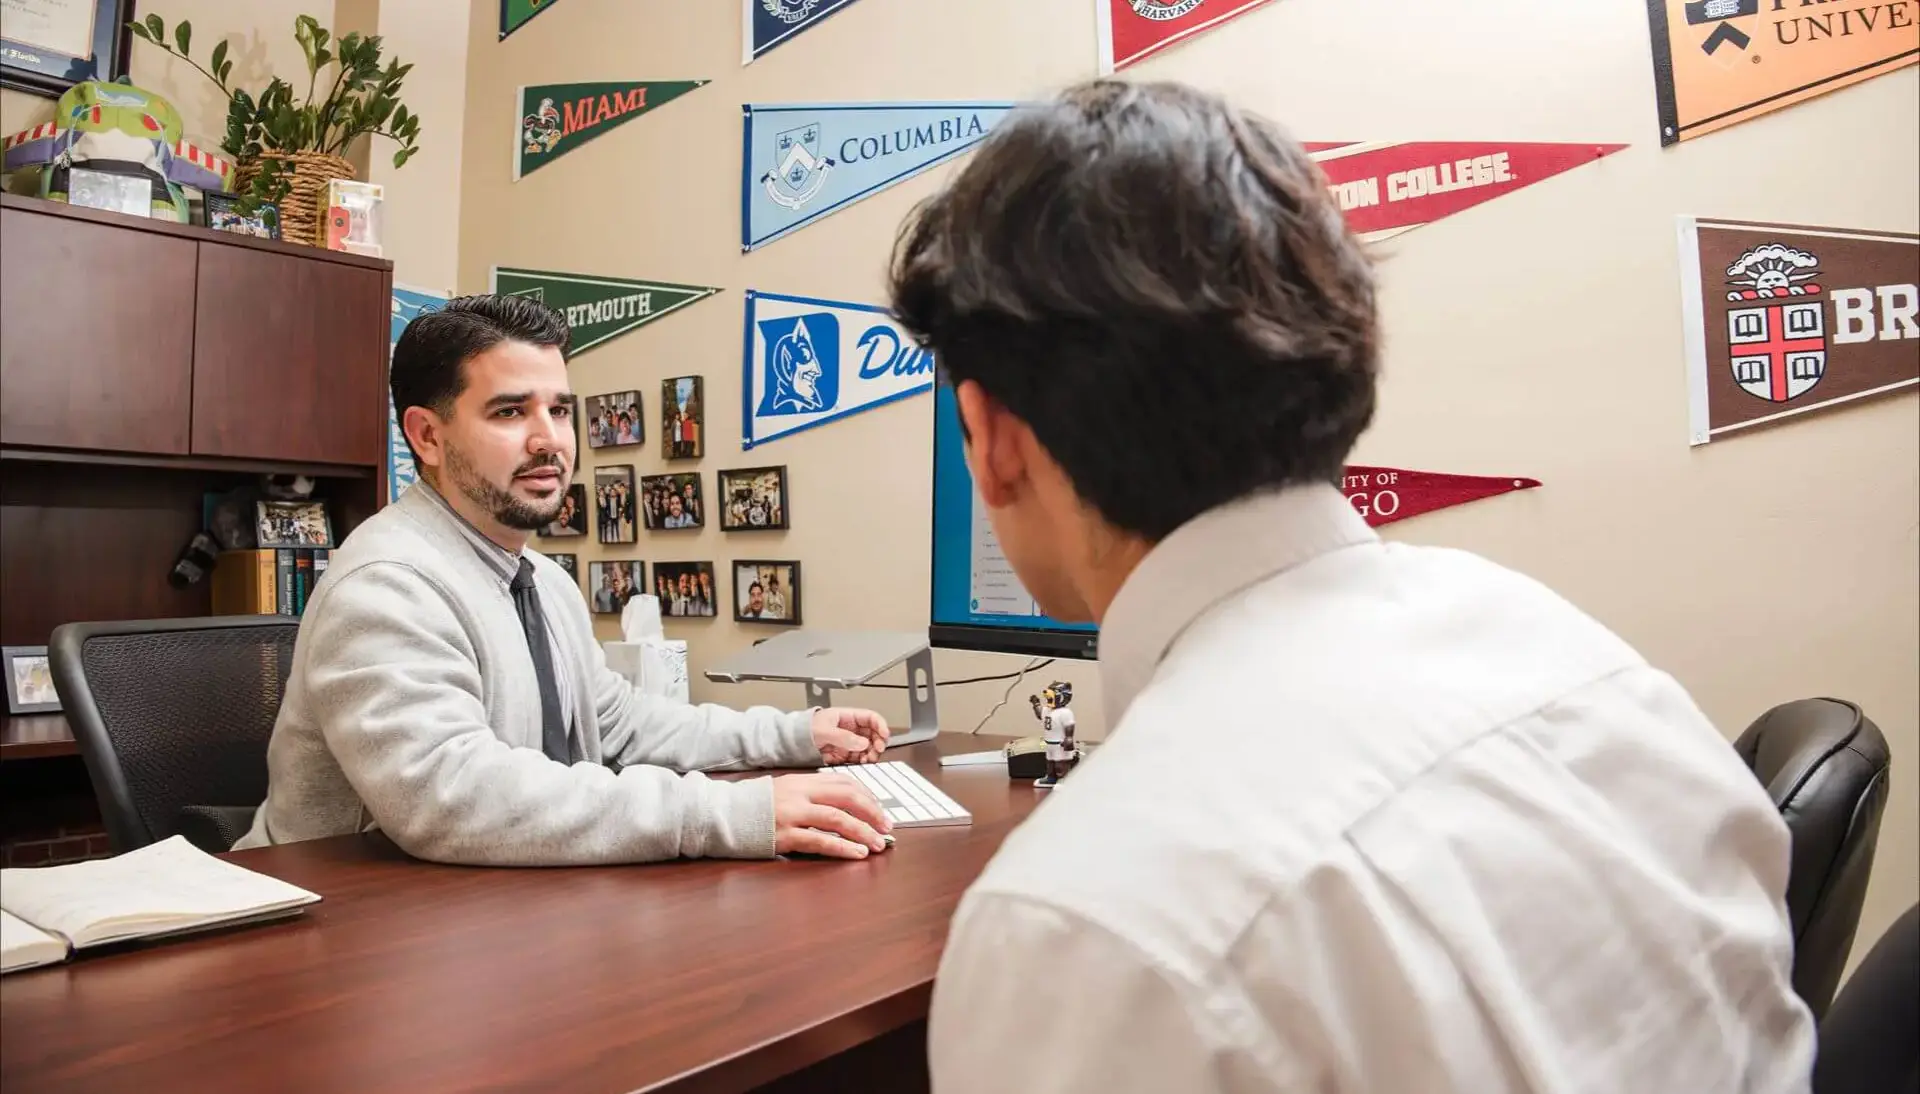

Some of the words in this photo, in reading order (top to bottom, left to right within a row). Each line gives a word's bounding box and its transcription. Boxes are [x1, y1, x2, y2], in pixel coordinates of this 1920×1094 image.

[1773, 1, 1919, 45] UNIVE
[561, 87, 648, 137] MIAMI
[839, 113, 985, 164] COLUMBIA
[1829, 283, 1919, 345] BR
[1341, 474, 1370, 489] ITY
[1376, 472, 1399, 485] OF
